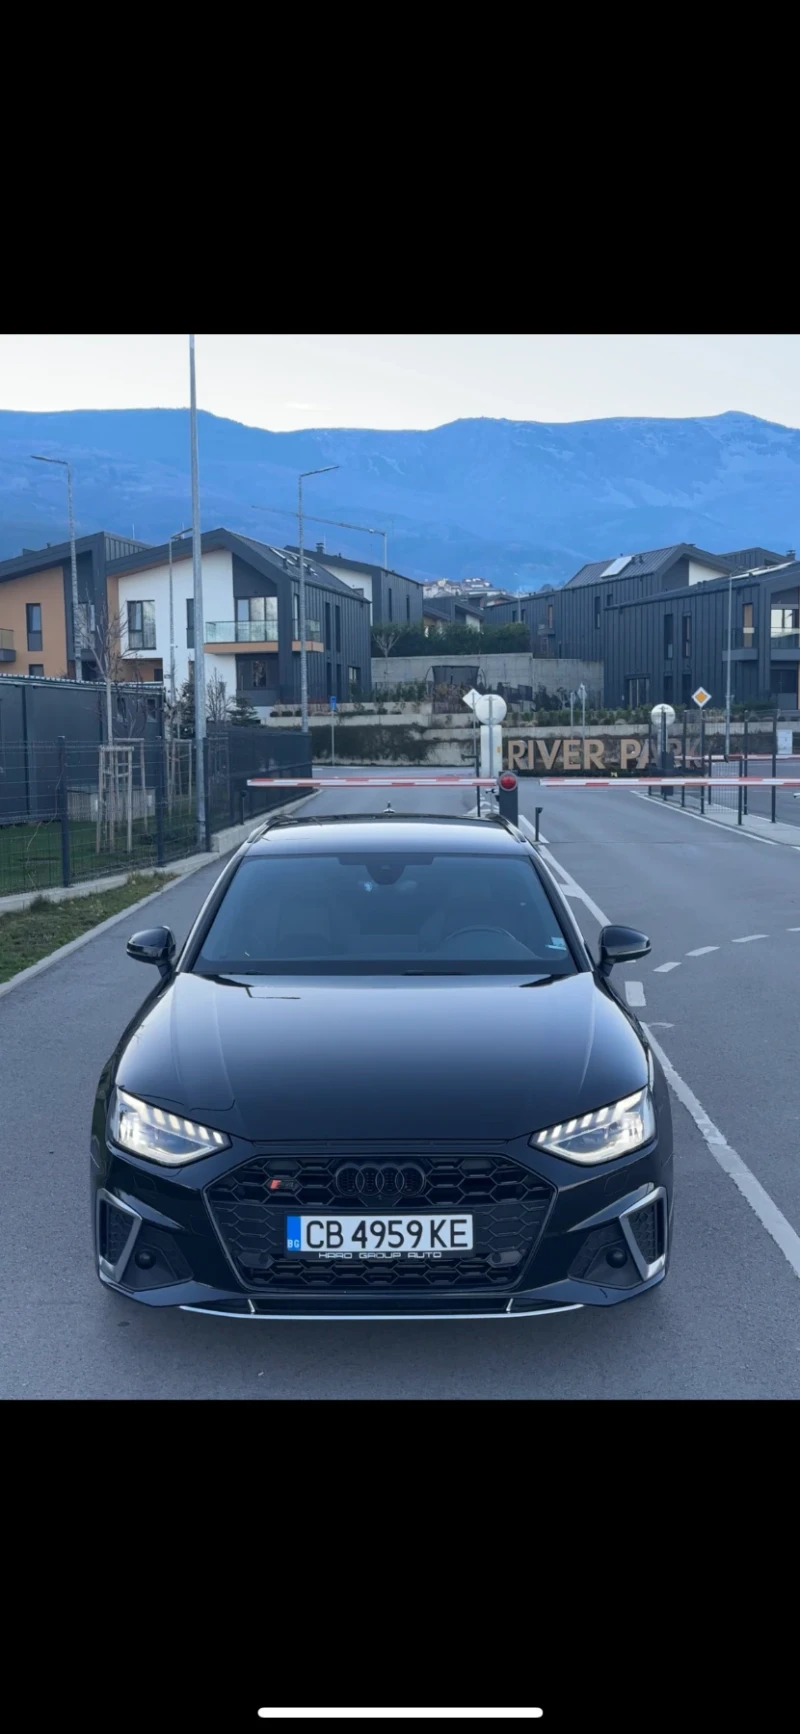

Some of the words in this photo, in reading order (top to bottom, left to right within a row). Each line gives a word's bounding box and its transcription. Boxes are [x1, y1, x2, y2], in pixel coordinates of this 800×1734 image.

[507, 739, 606, 770] RIVER
[287, 1239, 300, 1249] BG
[306, 1220, 344, 1249] CB
[351, 1220, 423, 1249] 4959
[430, 1219, 468, 1248] KE
[358, 1252, 402, 1260] GROUP
[407, 1251, 442, 1259] AUTO
